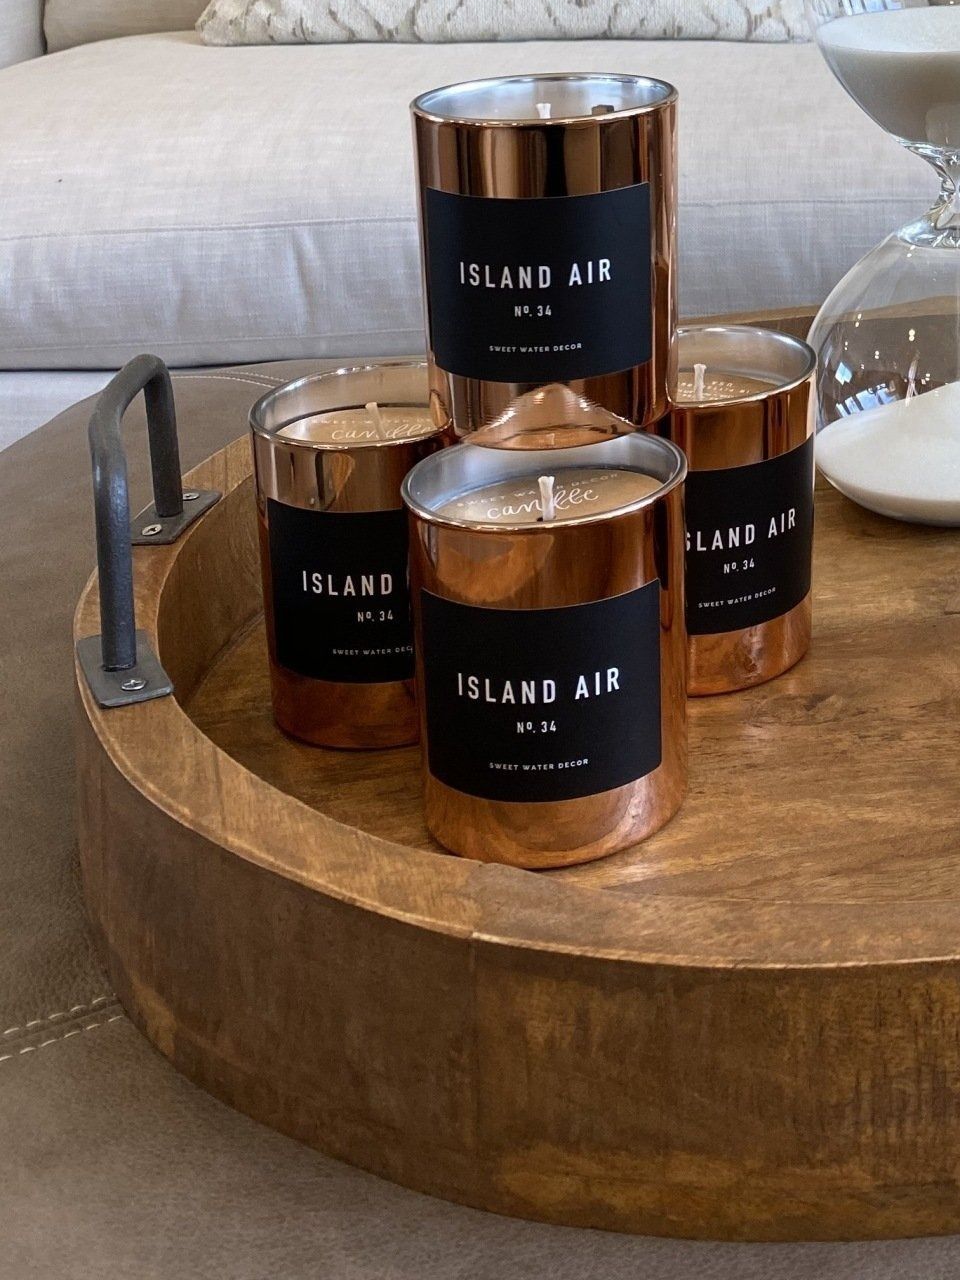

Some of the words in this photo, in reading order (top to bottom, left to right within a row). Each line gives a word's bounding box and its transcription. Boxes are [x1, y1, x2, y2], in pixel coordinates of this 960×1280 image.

[459, 261, 551, 289] ISLAND
[568, 258, 612, 287] AIR
[536, 304, 552, 317] 34
[488, 345, 517, 353] SWEET
[519, 345, 550, 353] WATER
[552, 342, 582, 352] DECOR
[685, 523, 756, 552] SLAND
[767, 507, 796, 539] AIR
[742, 557, 755, 571] 34
[302, 570, 393, 597] ISLAND
[698, 600, 725, 609] SWEET
[726, 594, 753, 605] WATER
[754, 586, 776, 599] DECOR
[379, 609, 394, 622] 34
[332, 648, 359, 656] SWEET
[362, 648, 392, 656] WATER
[457, 672, 556, 705] ISLAND
[574, 667, 620, 700] AIR
[540, 720, 557, 733] 34
[489, 762, 519, 771] SWEET
[522, 763, 555, 771] WATER
[557, 758, 589, 770] DECOR
